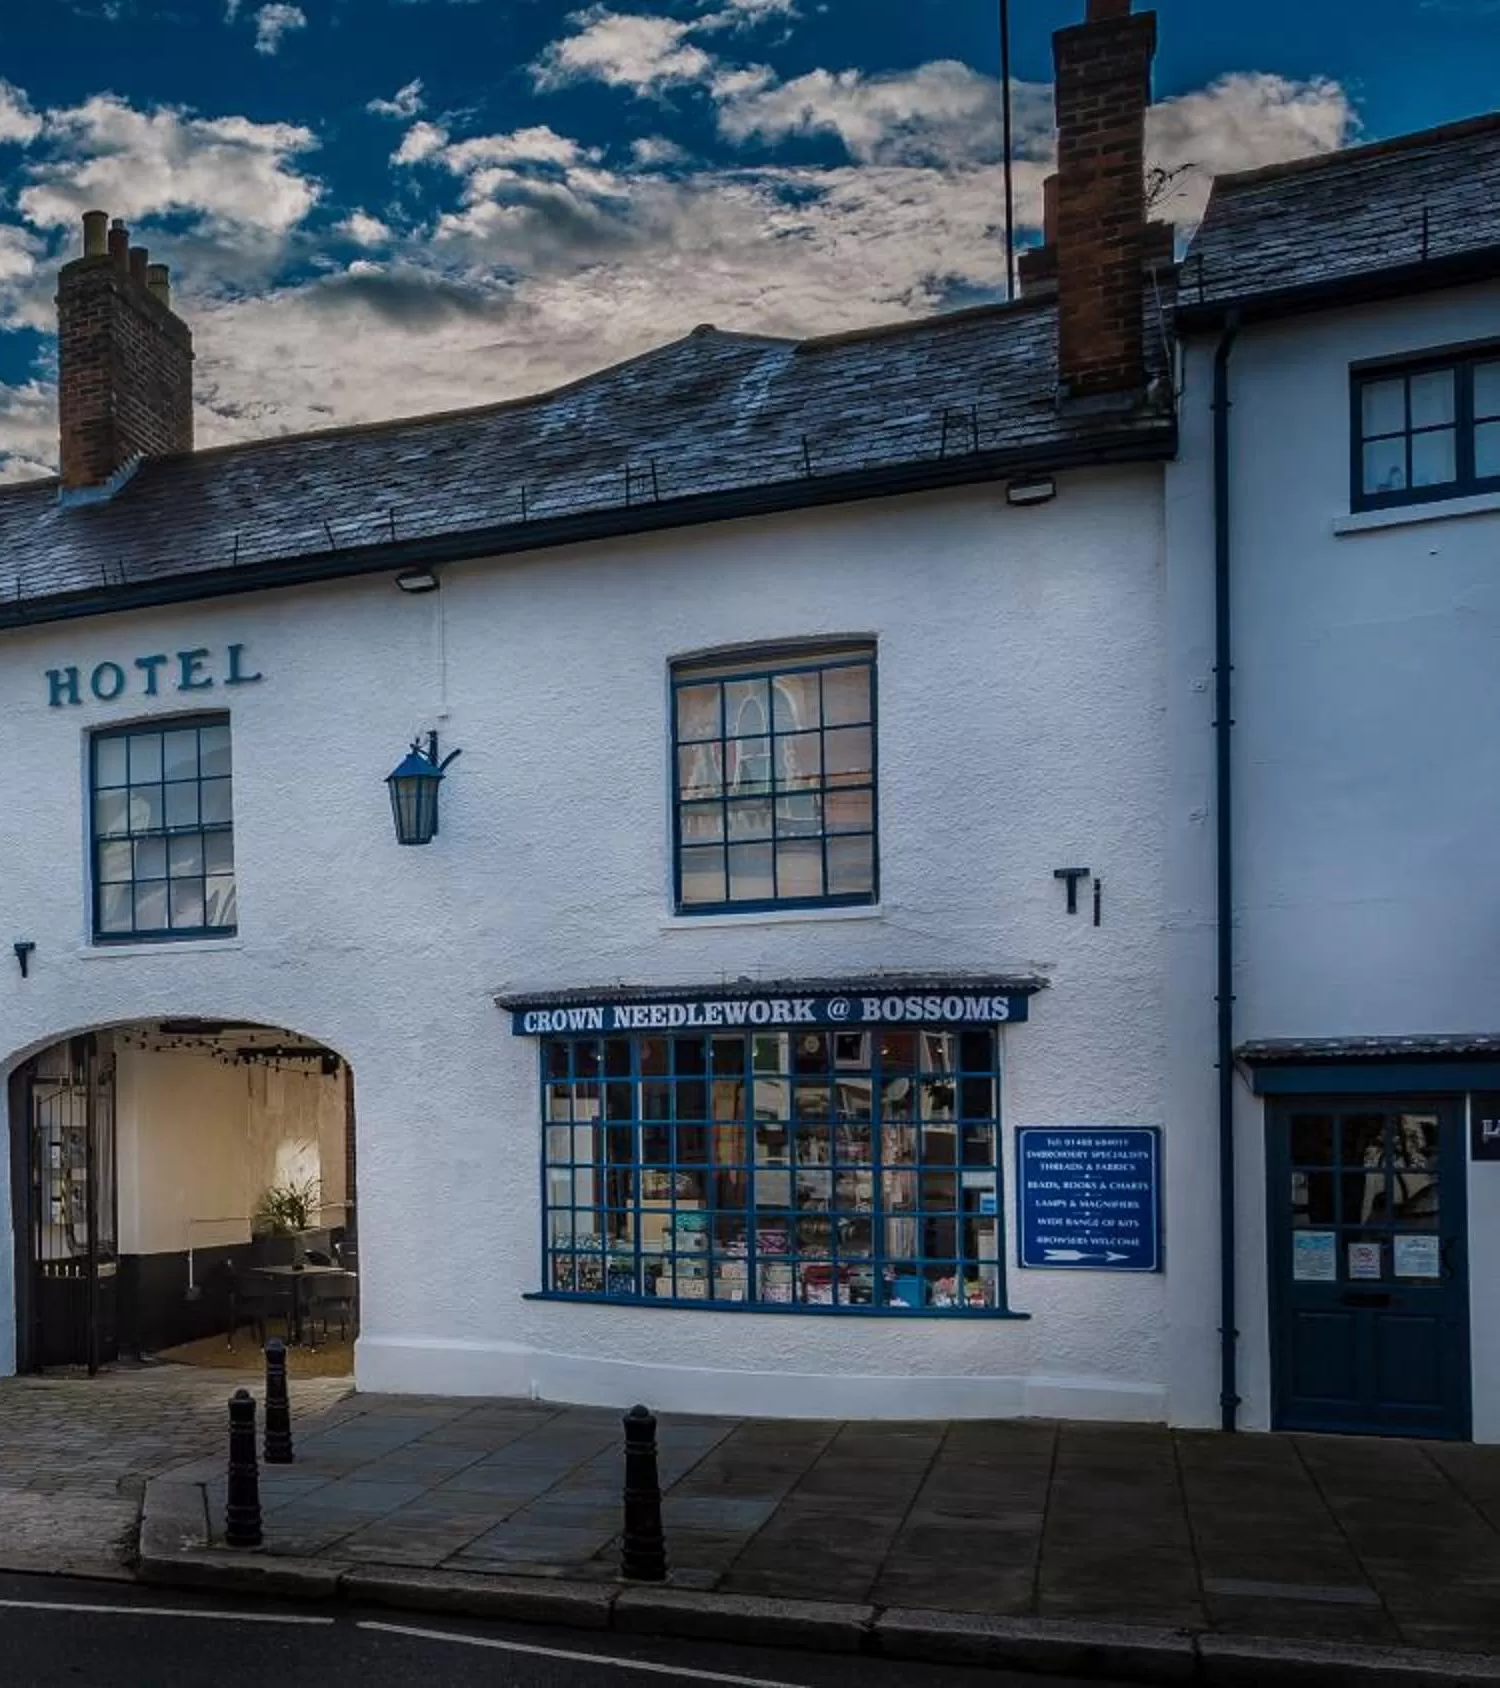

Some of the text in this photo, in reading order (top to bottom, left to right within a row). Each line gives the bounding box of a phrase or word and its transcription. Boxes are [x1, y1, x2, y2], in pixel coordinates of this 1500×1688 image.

[44, 643, 263, 708] HOTEL
[523, 995, 1010, 1033] CROWN NEEDLEWORK @ BOSSOMS
[1026, 1151, 1149, 1159] EMBROIDERY SPECIALISTS
[1040, 1163, 1136, 1171] THREADS & FABRICS
[1027, 1181, 1149, 1190] BEADS, BOOKS & CHARTS
[1035, 1199, 1140, 1209] LAMPS & MAGNIFIERS
[1037, 1217, 1140, 1228] WIDE RANGE OF KITS
[1035, 1235, 1140, 1246] BROWSERS WELCOME
